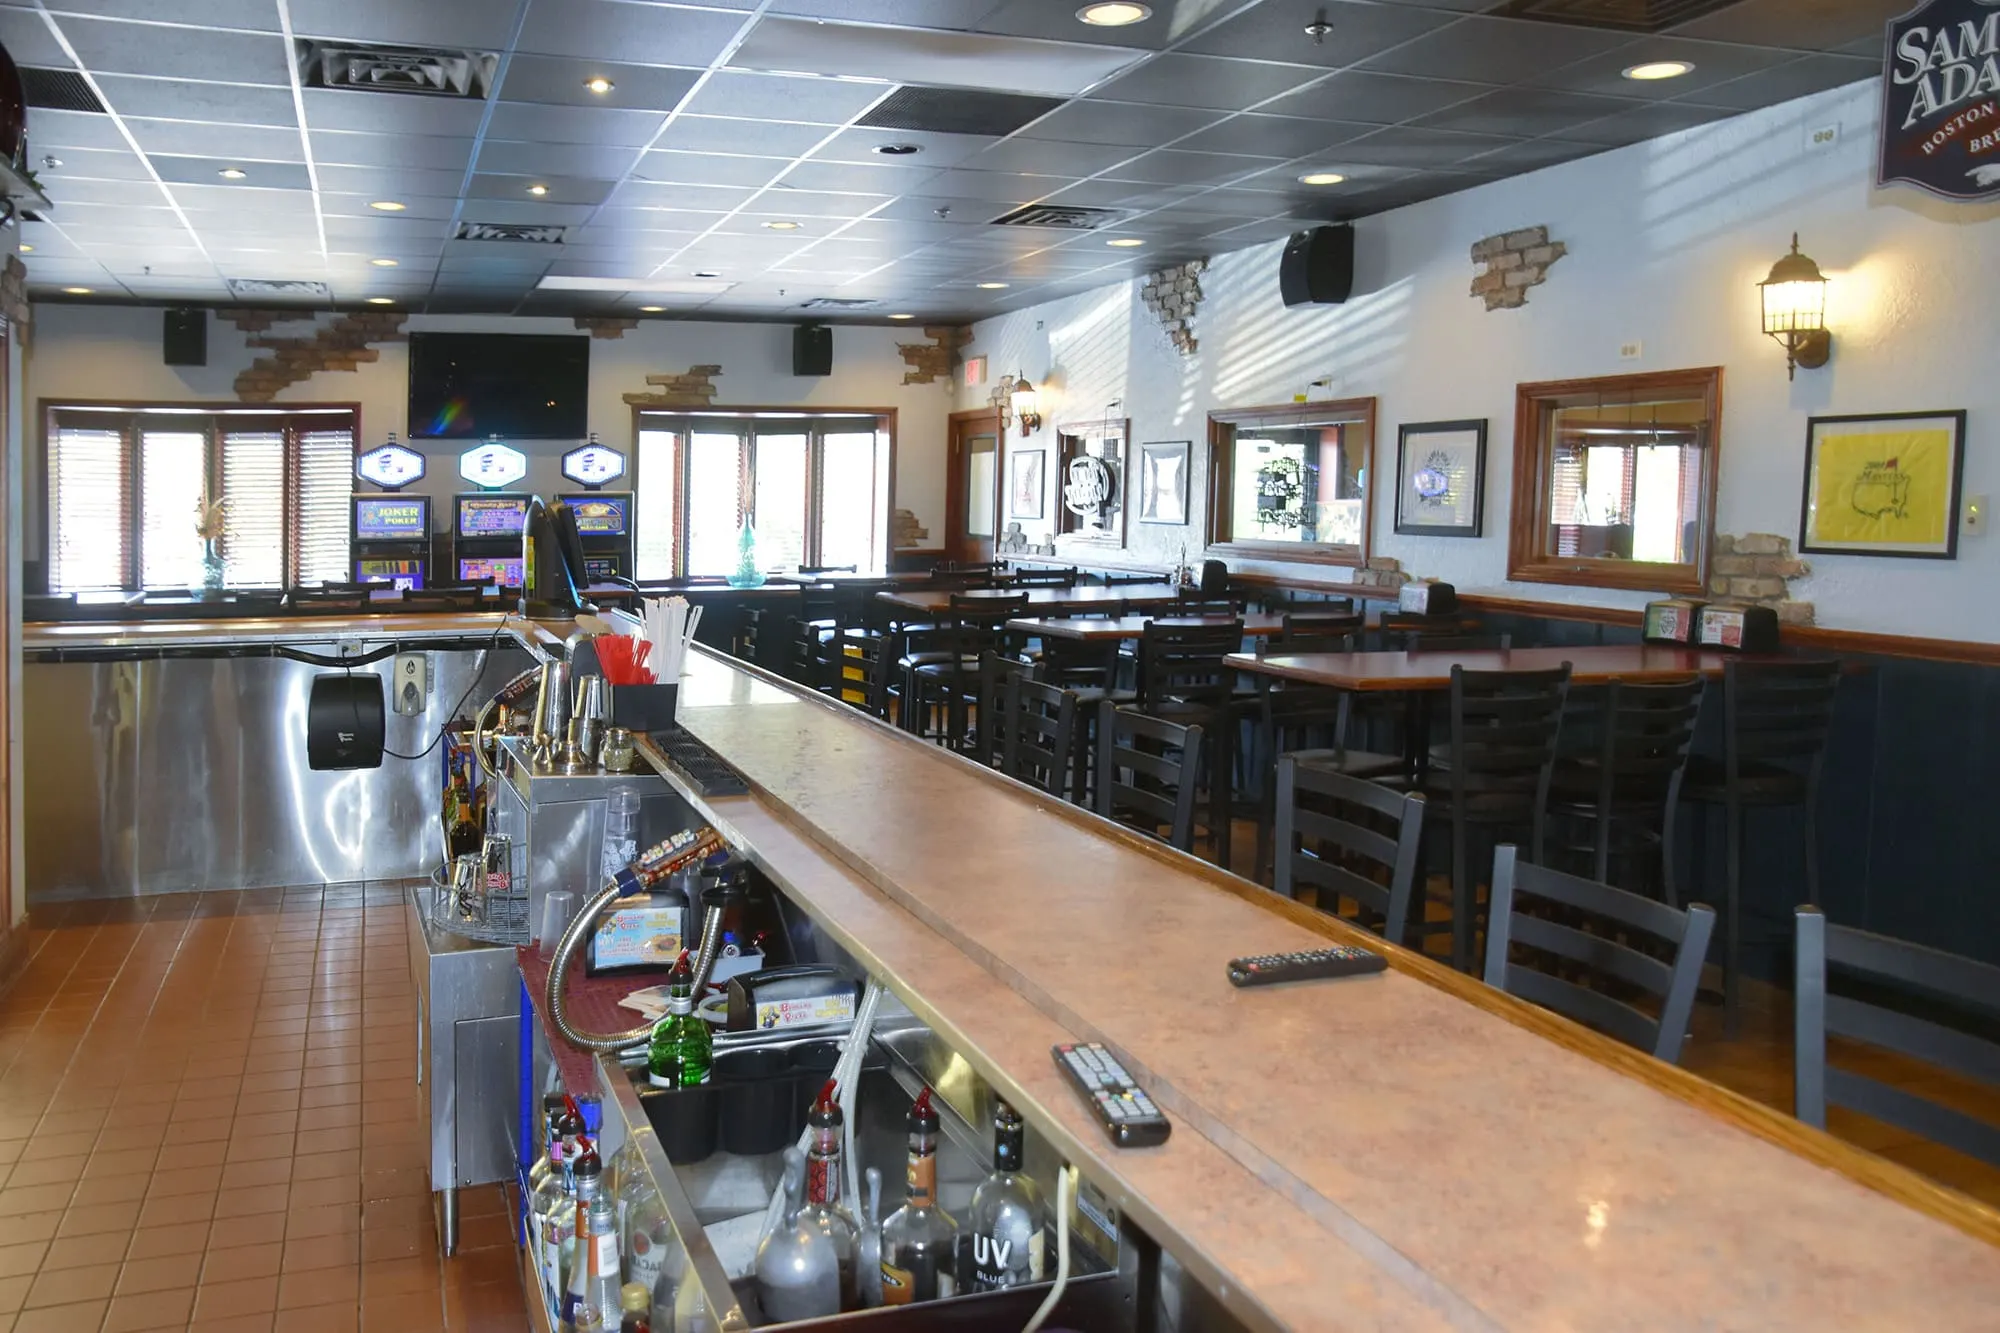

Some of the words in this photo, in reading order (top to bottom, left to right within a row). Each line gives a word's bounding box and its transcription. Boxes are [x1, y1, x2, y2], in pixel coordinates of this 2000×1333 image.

[1893, 12, 2000, 84] SAM
[1921, 101, 1995, 155] BOSTON
[378, 507, 418, 517] JOKER
[385, 517, 417, 525] POKER
[973, 1232, 1012, 1269] UV
[976, 1270, 1006, 1285] BLUE
